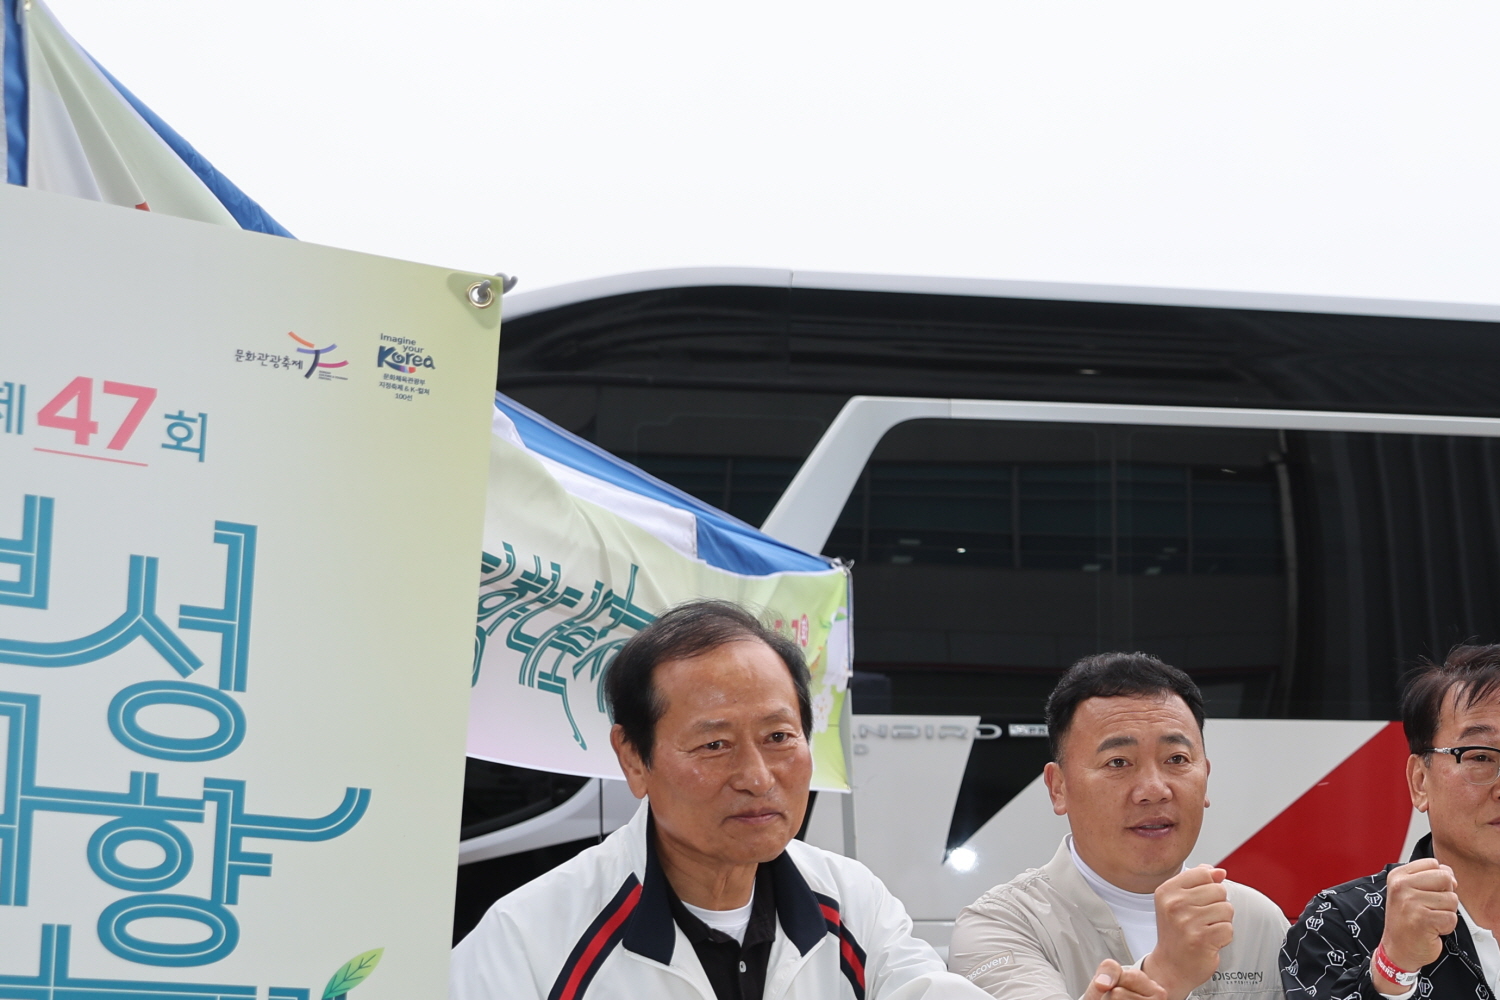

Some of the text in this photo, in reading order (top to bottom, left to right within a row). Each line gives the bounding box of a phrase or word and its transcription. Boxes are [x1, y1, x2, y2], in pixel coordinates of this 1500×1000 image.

[380, 333, 417, 346] Imagine
[402, 344, 425, 354] your
[234, 348, 304, 370] 문화관광축제
[377, 345, 436, 372] Korea
[382, 372, 426, 386] 문화체육관광부
